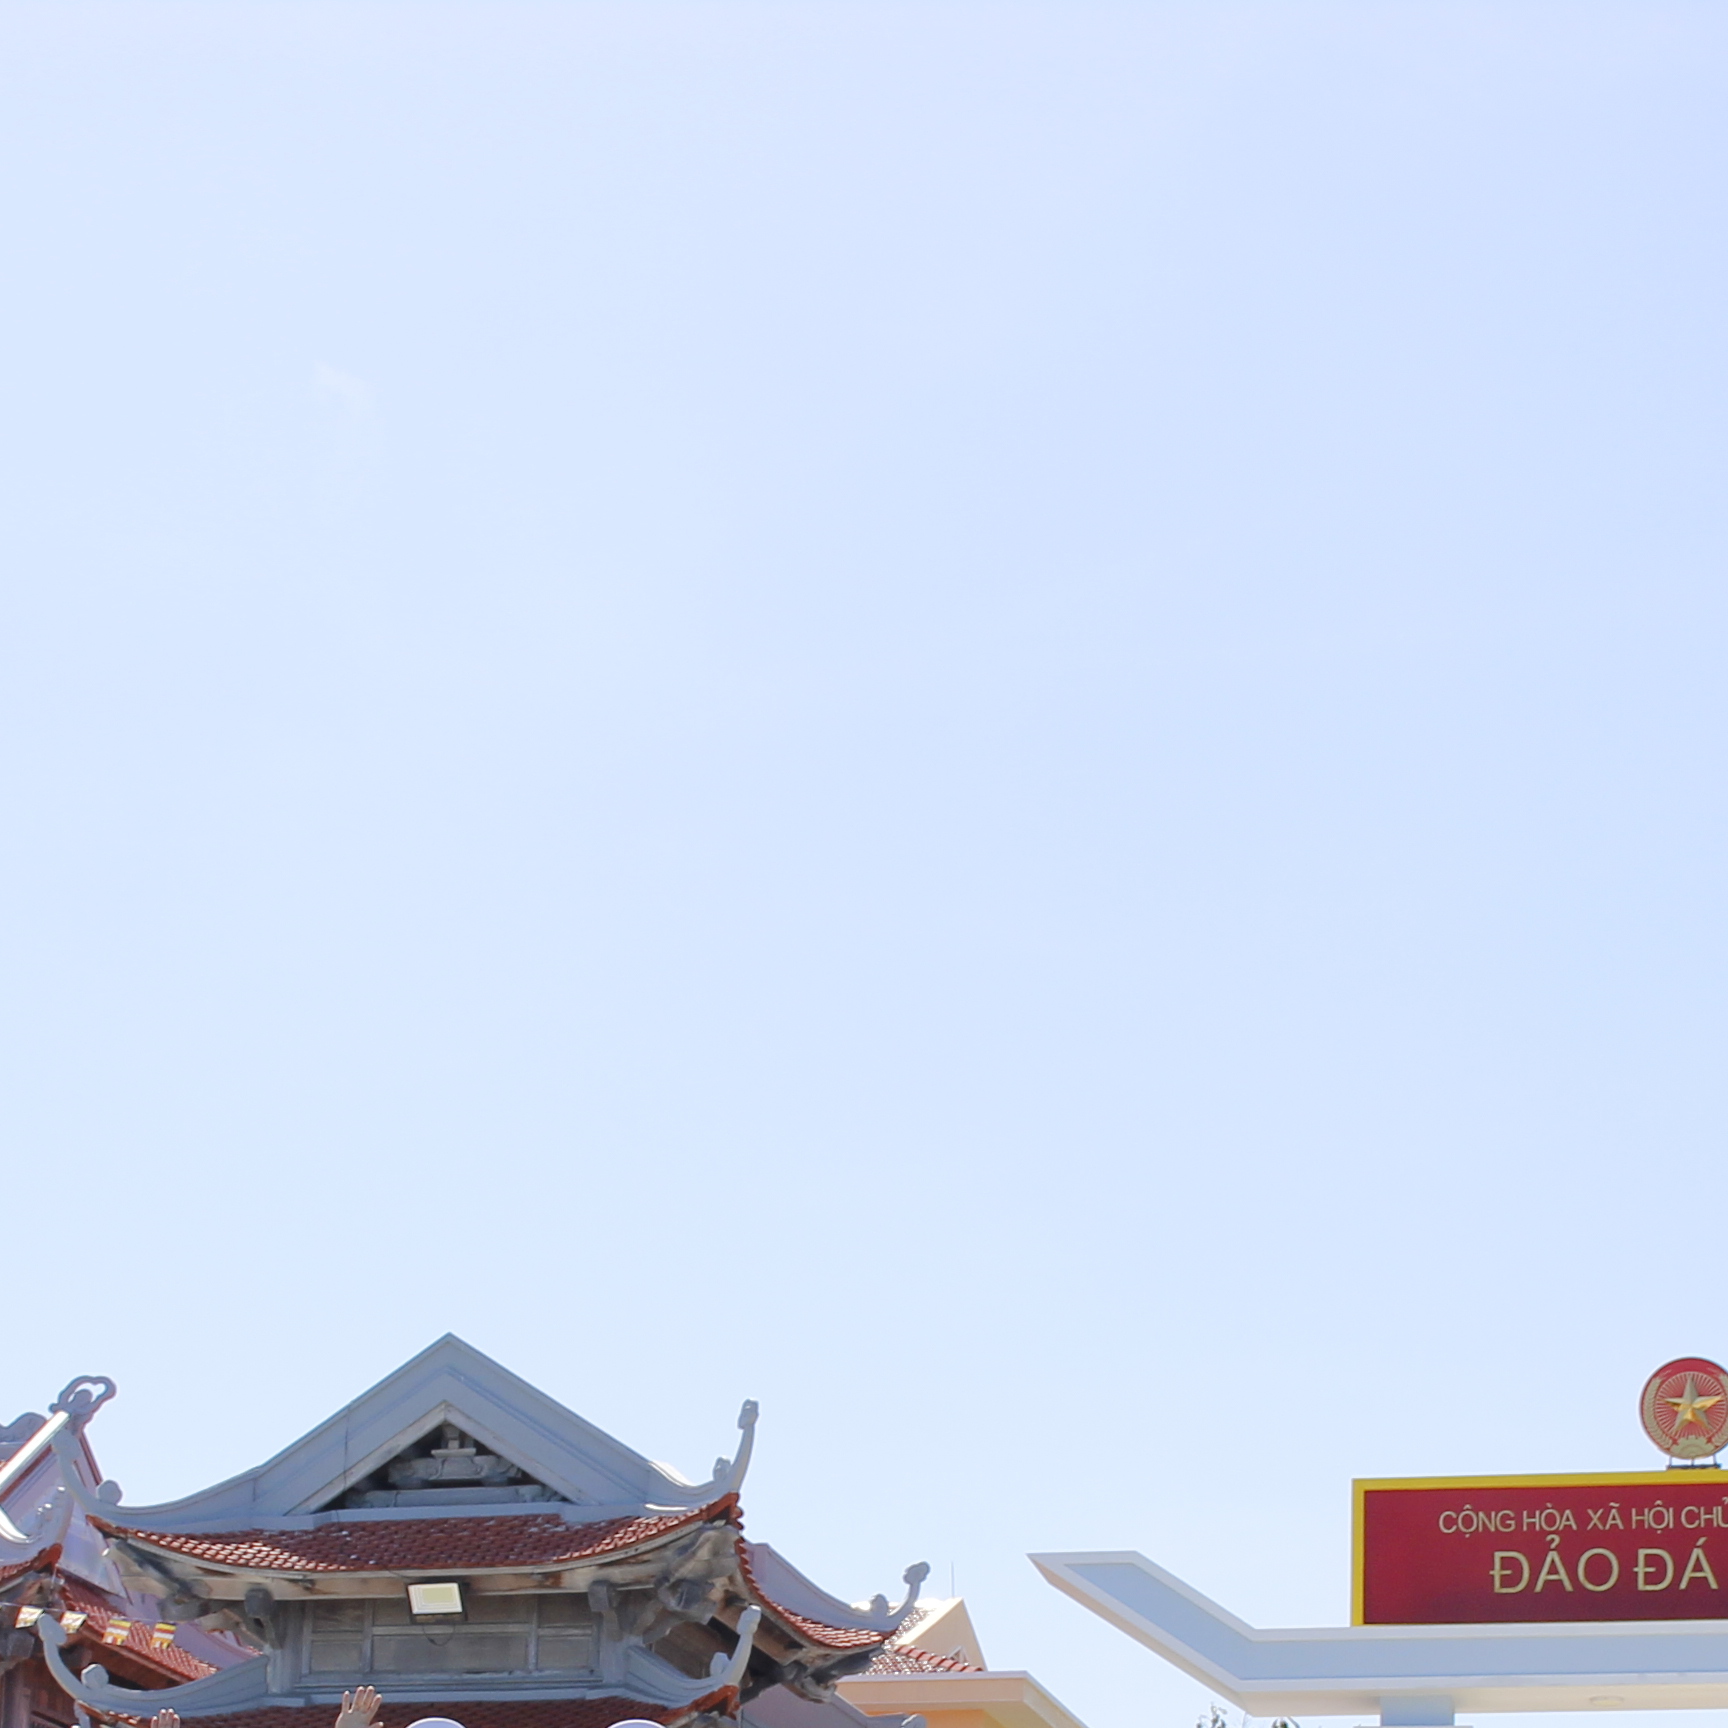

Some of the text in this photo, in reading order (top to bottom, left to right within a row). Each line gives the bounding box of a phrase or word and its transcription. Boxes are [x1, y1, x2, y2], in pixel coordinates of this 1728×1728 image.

[1438, 1504, 1516, 1538] CỘNG
[1522, 1503, 1577, 1531] HÒA
[1586, 1502, 1624, 1530] XÃ
[1631, 1500, 1674, 1534] HỘI
[1489, 1534, 1619, 1593] ĐẢO
[1633, 1536, 1719, 1591] ĐÁ
